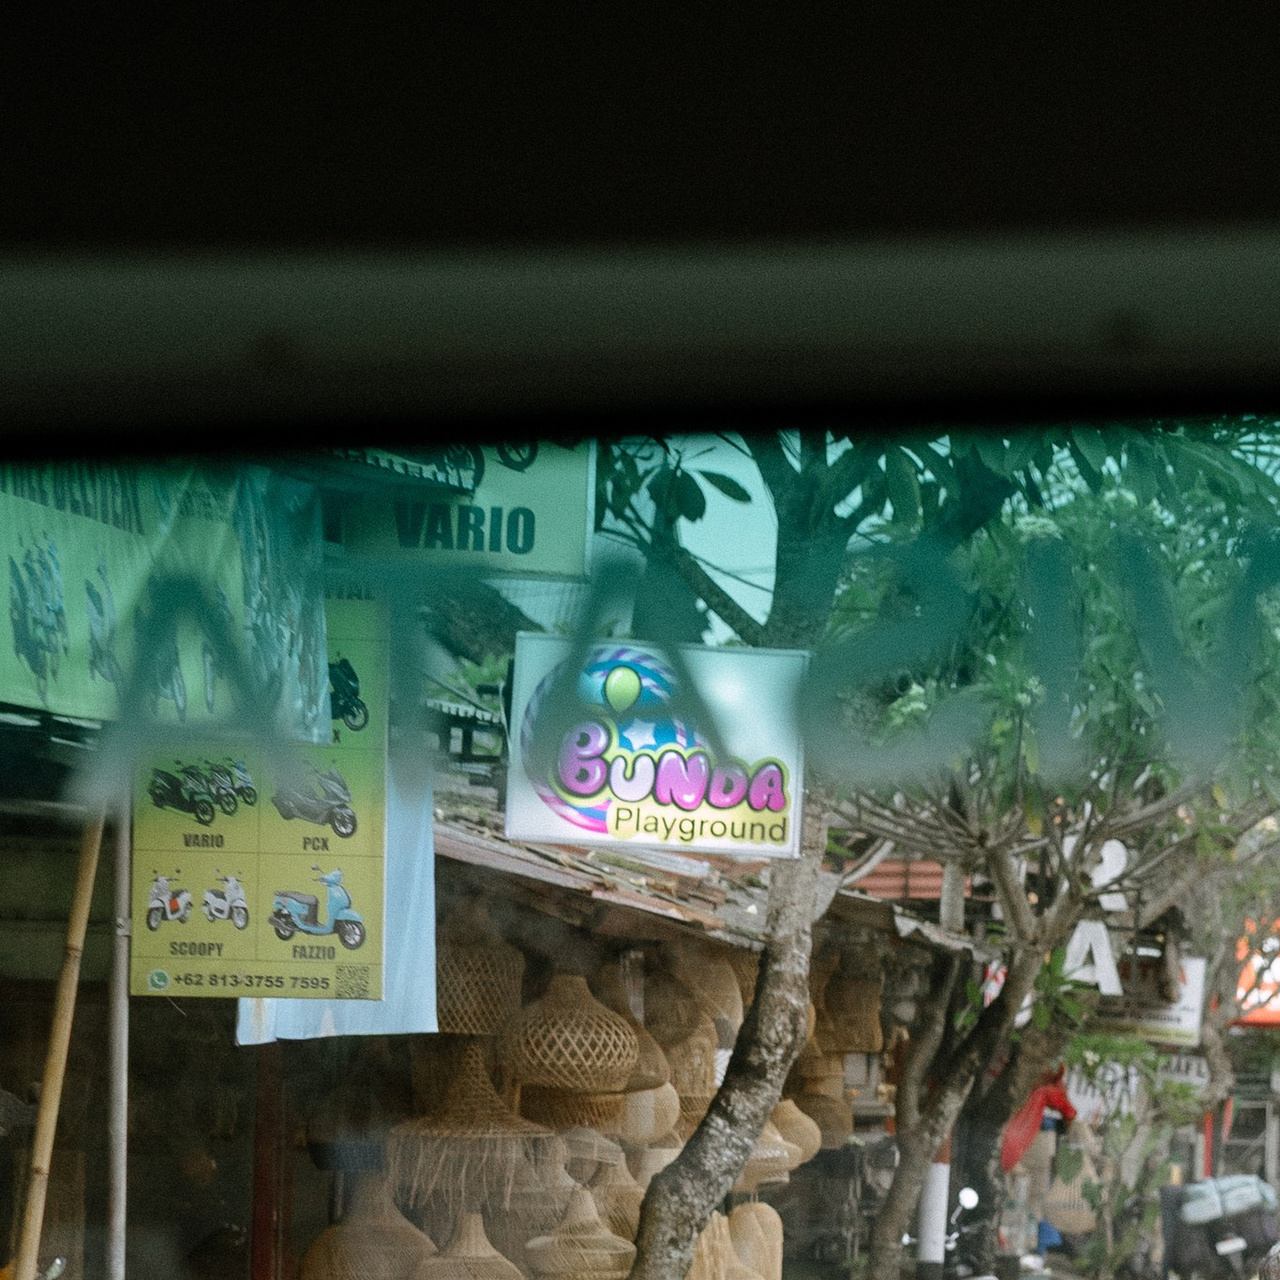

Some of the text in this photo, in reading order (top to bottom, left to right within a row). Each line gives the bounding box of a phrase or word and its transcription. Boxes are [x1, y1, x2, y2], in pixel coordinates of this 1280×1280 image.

[396, 503, 535, 555] VARIO
[557, 718, 787, 812] BUNDA
[614, 807, 787, 843] Playground
[183, 833, 224, 848] VARIO
[302, 837, 330, 852] PCX
[169, 942, 224, 957] SCOOPY
[292, 945, 336, 960] FAZZIO
[174, 974, 203, 987] +62
[290, 977, 330, 990] 7595
